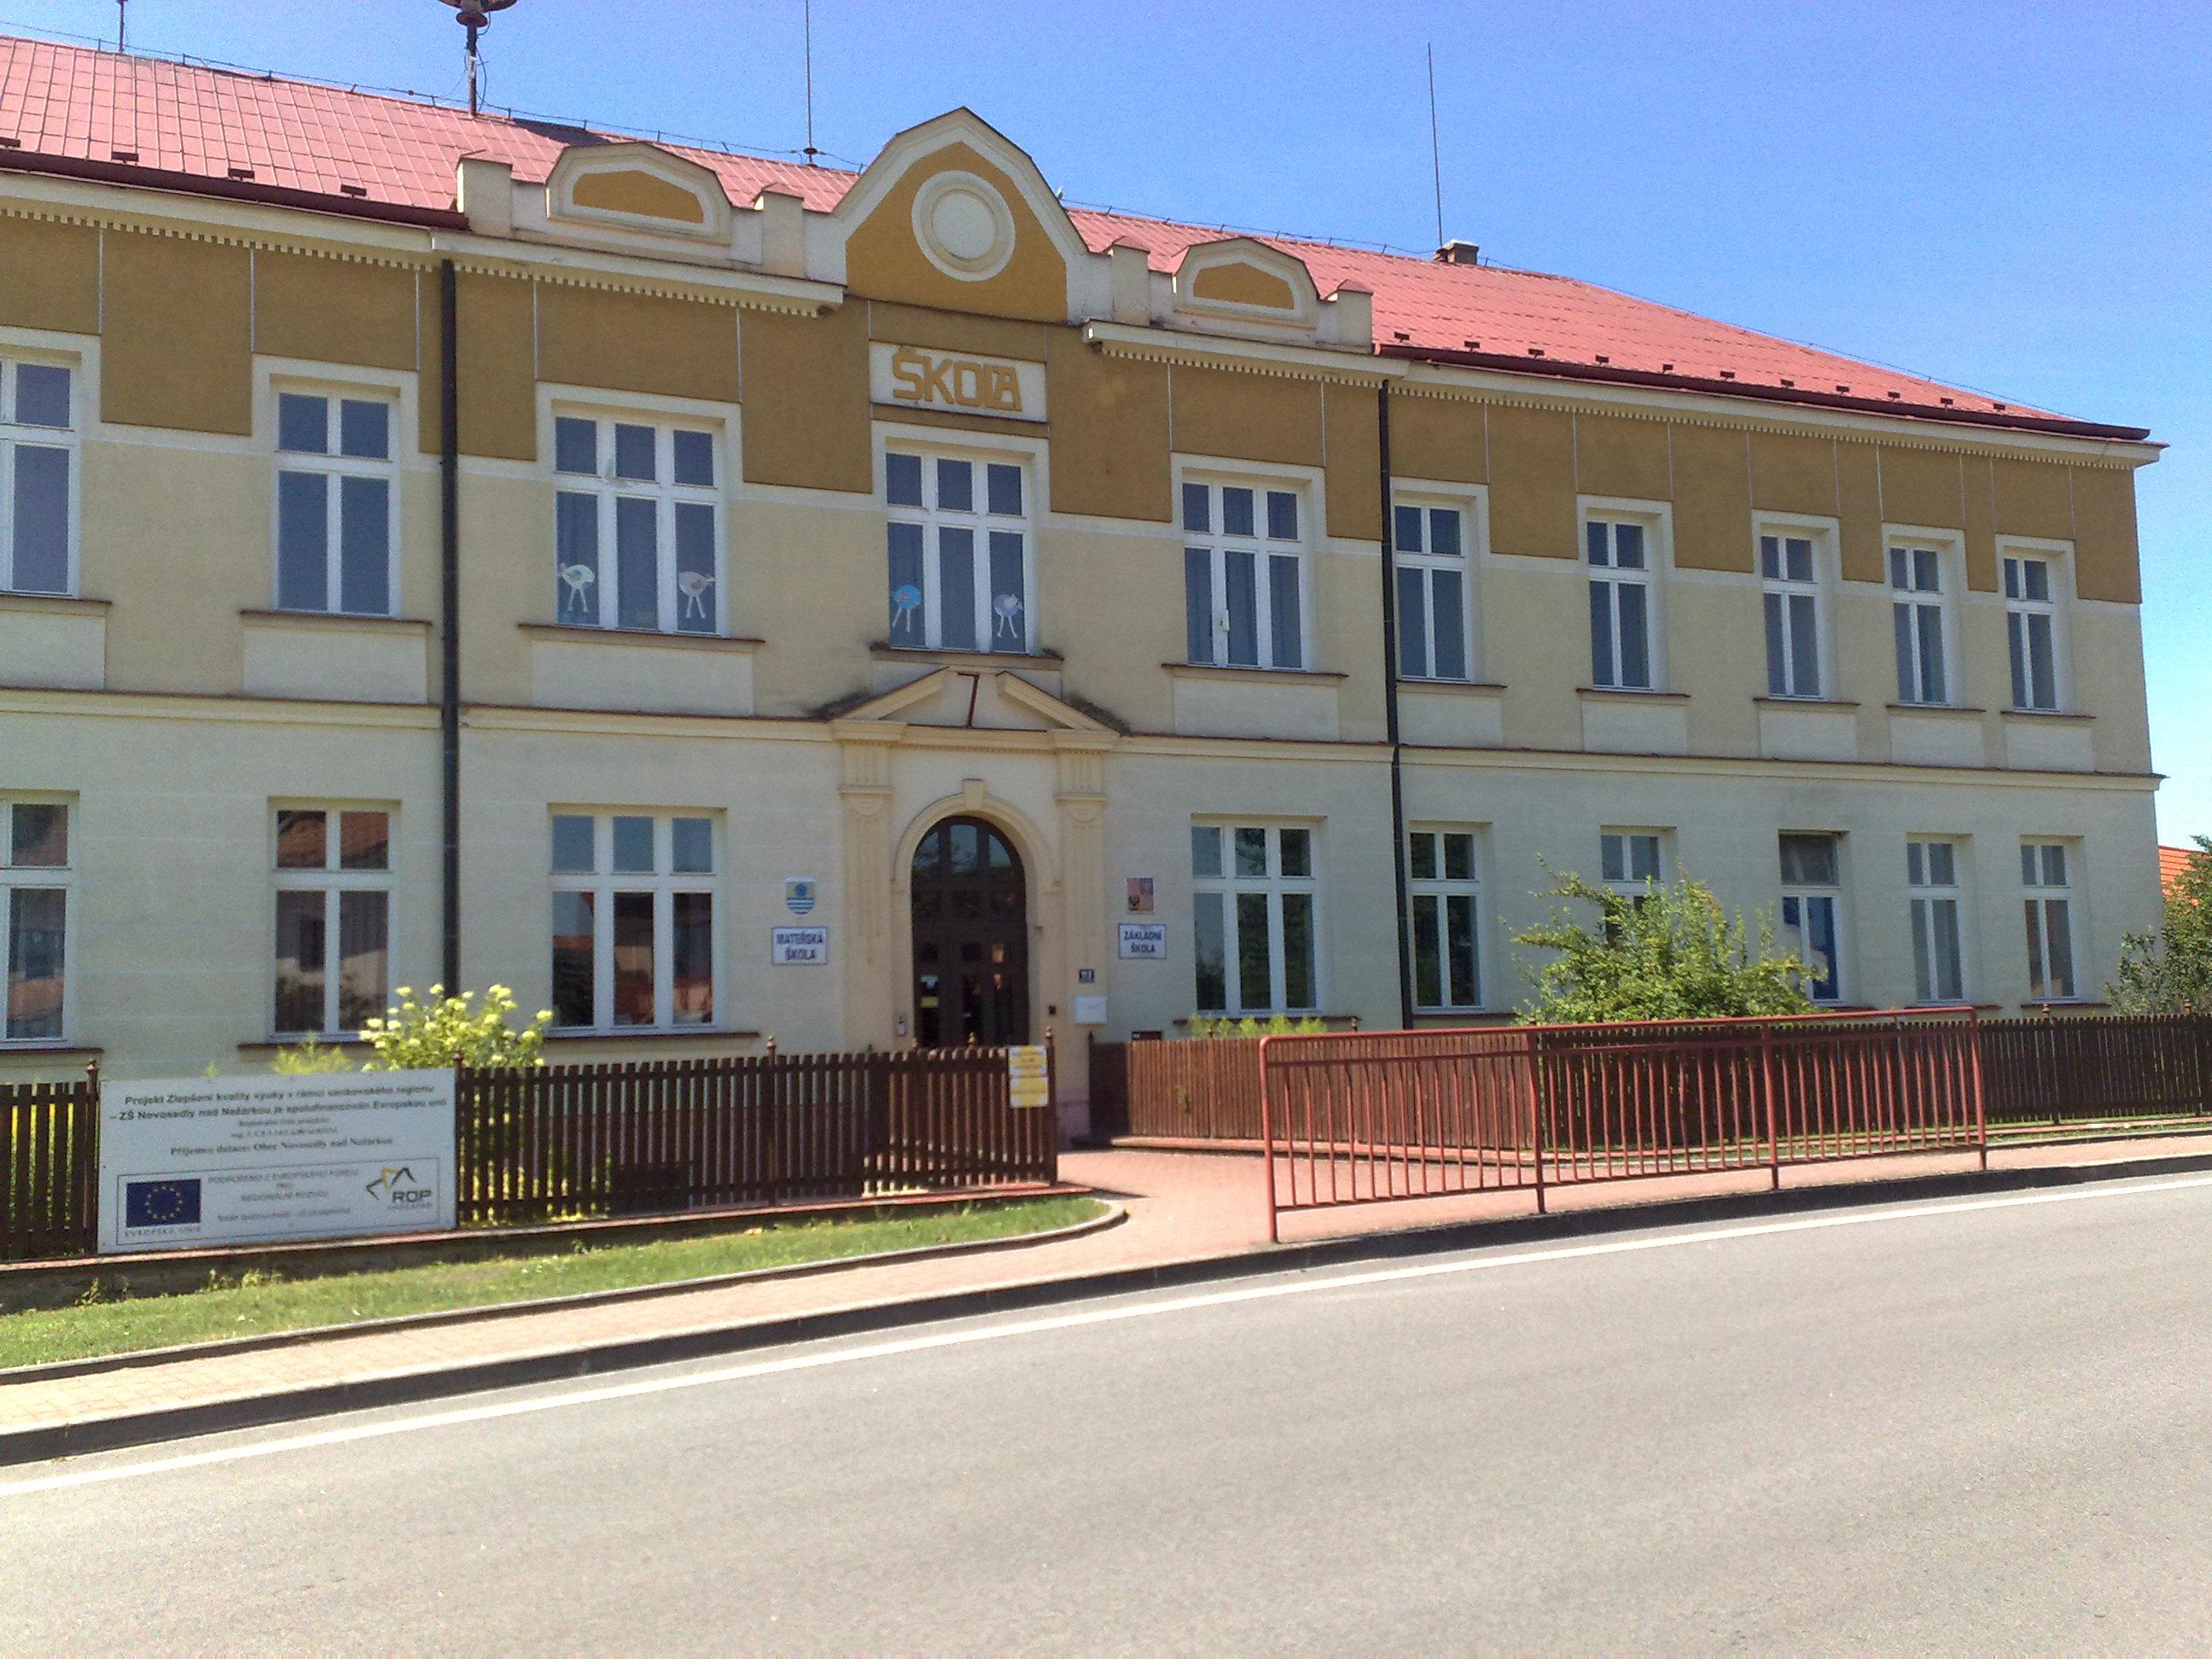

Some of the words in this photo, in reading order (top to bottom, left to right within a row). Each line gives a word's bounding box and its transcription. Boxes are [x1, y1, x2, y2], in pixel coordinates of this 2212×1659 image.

[892, 346, 1022, 412] ŠKOLA
[1131, 942, 1155, 953] ŠKOLA
[125, 1096, 164, 1106] Projekt
[119, 1110, 135, 1121] ZŠ
[137, 1109, 195, 1121] Novosedly
[393, 1189, 432, 1202] ROP
